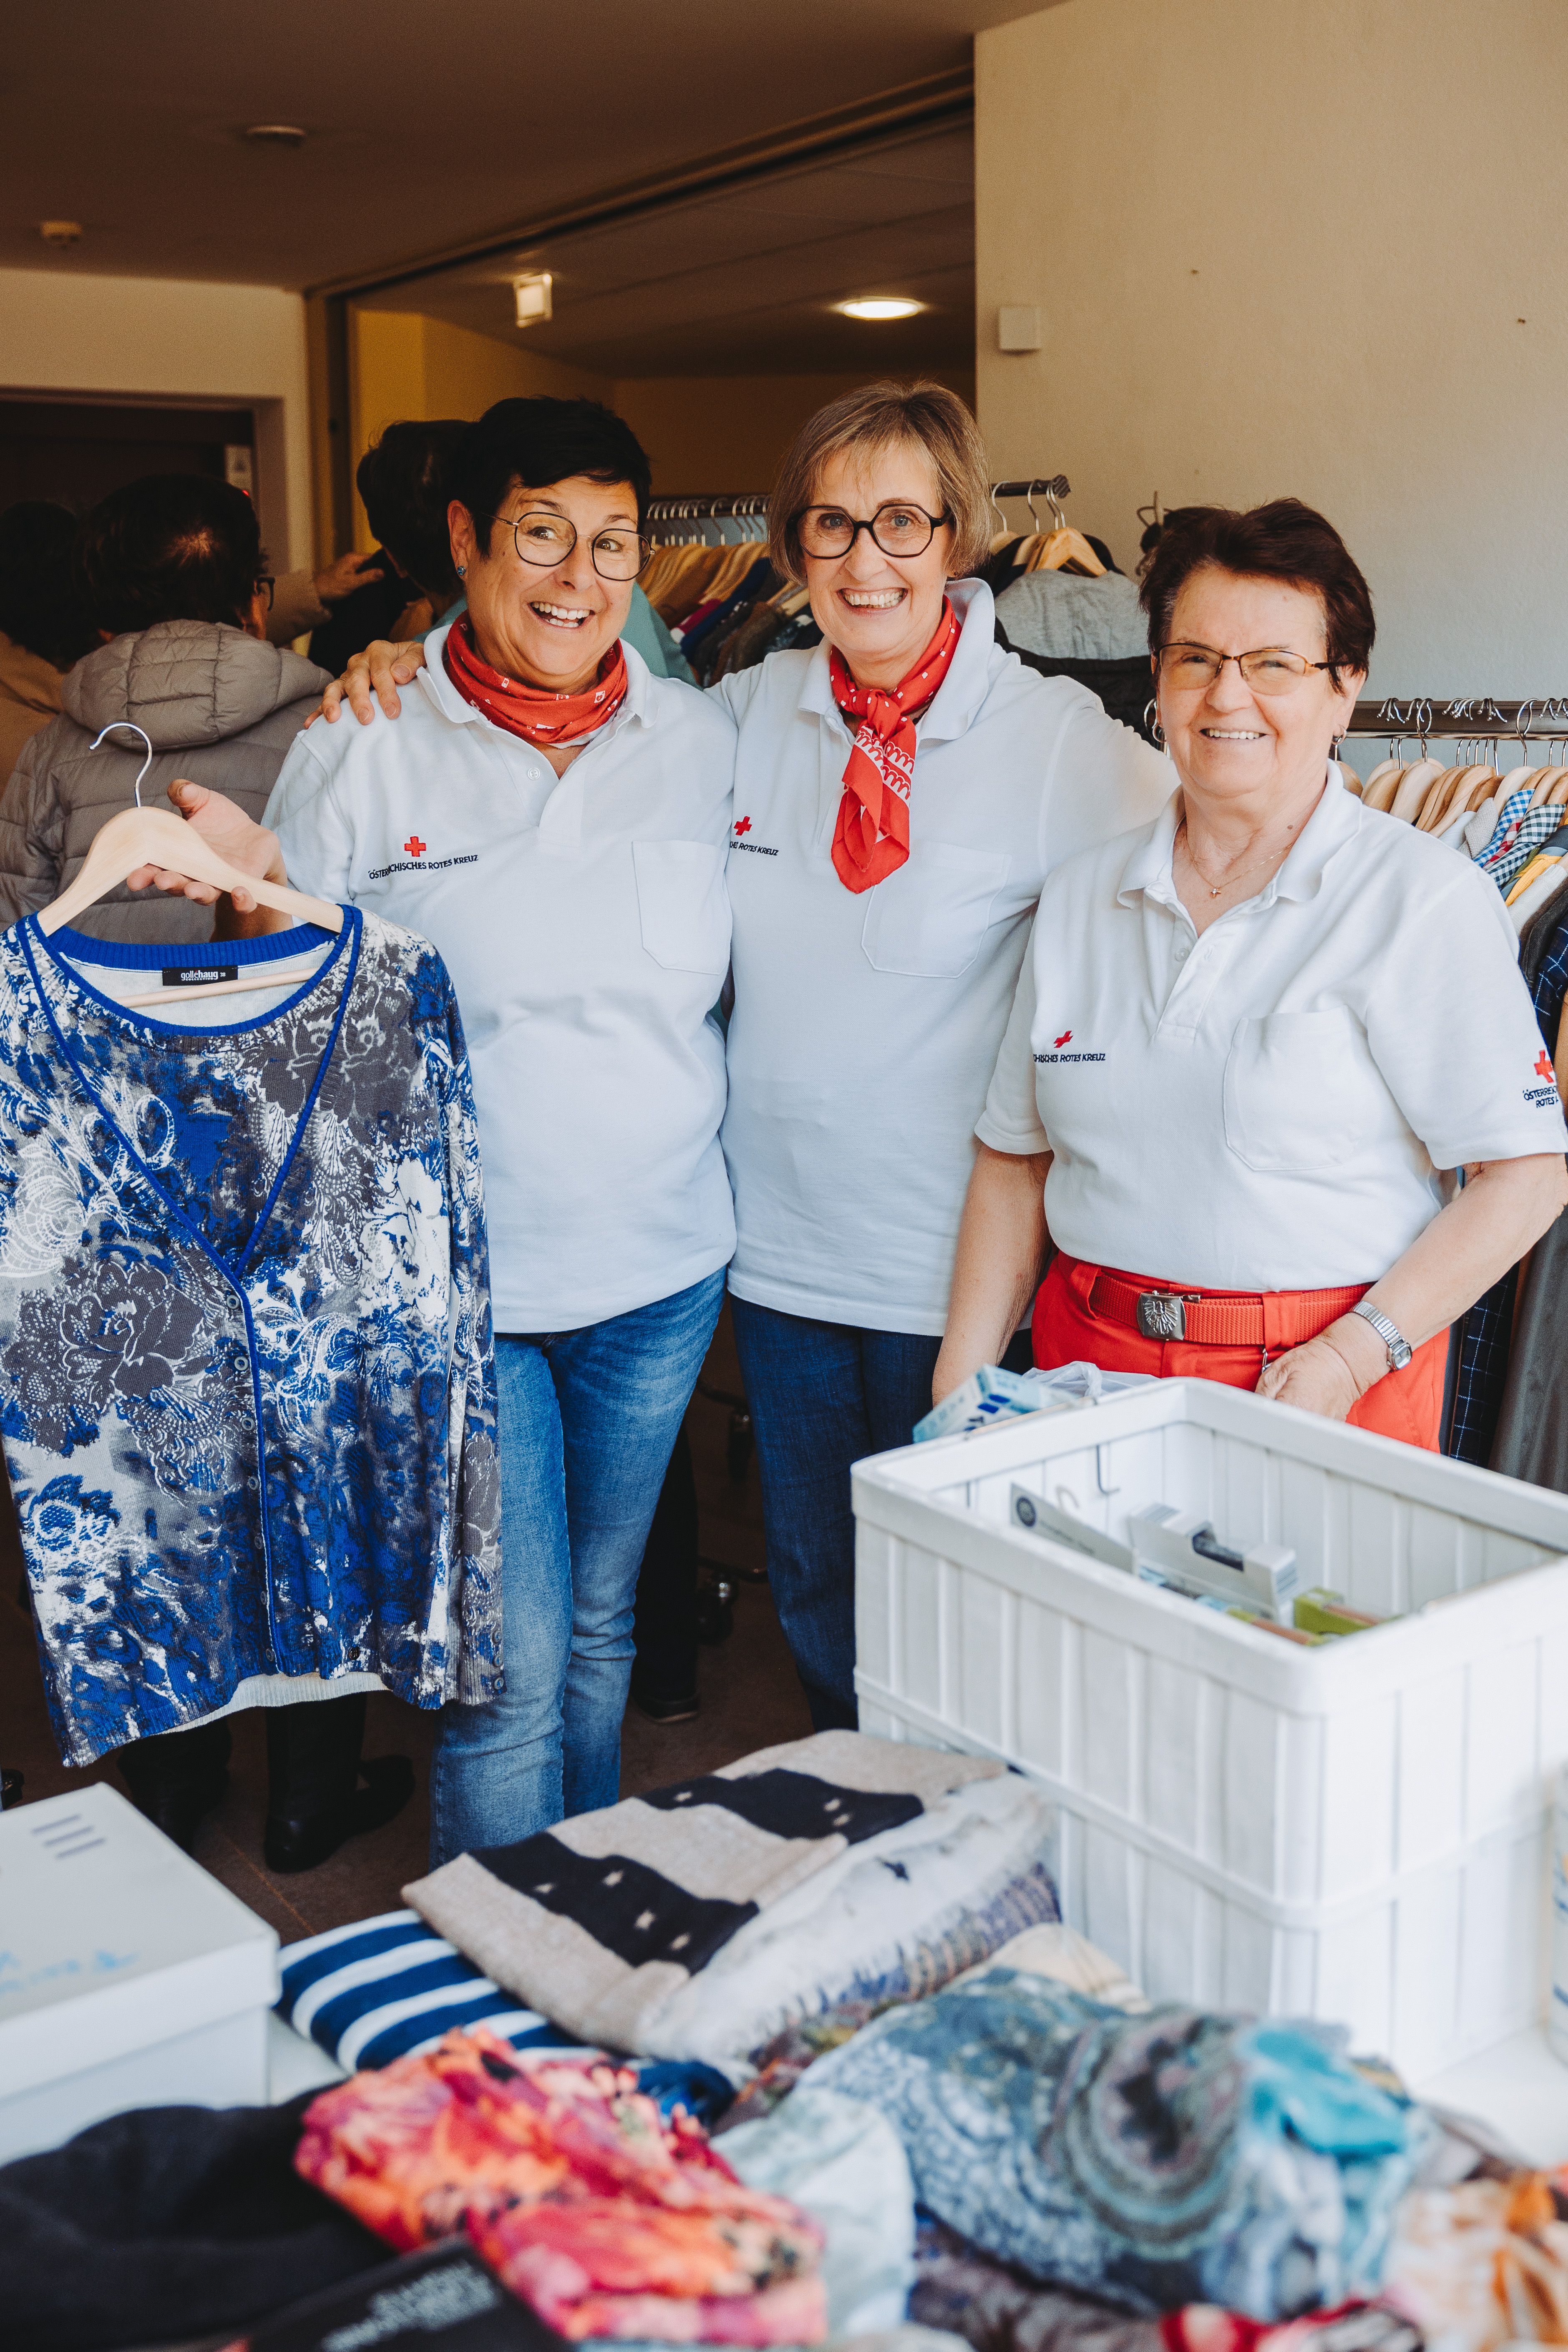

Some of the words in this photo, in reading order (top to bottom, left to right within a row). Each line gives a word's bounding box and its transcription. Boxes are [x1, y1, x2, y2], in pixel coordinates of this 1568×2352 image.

[738, 843, 758, 852] ROTES
[757, 846, 779, 856] KREUZ
[428, 859, 452, 870] ROTES
[453, 854, 478, 865] KREUZ
[1060, 1054, 1081, 1062] ROTES
[1082, 1053, 1105, 1062] KREUZ
[1536, 1097, 1555, 1108] ROTES
